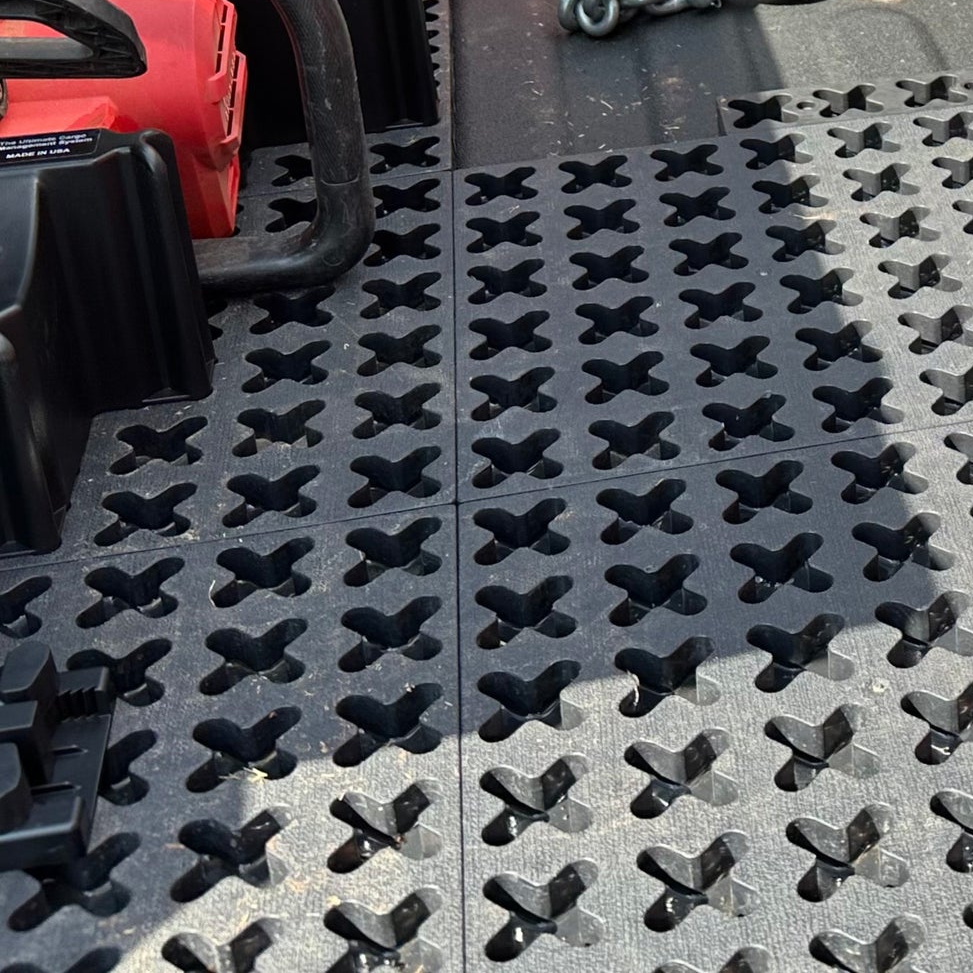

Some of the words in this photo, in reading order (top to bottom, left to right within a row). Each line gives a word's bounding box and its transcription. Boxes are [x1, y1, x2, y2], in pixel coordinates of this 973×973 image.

[18, 136, 57, 145] Ultimate
[58, 137, 93, 146] System
[5, 151, 36, 159] MADE
